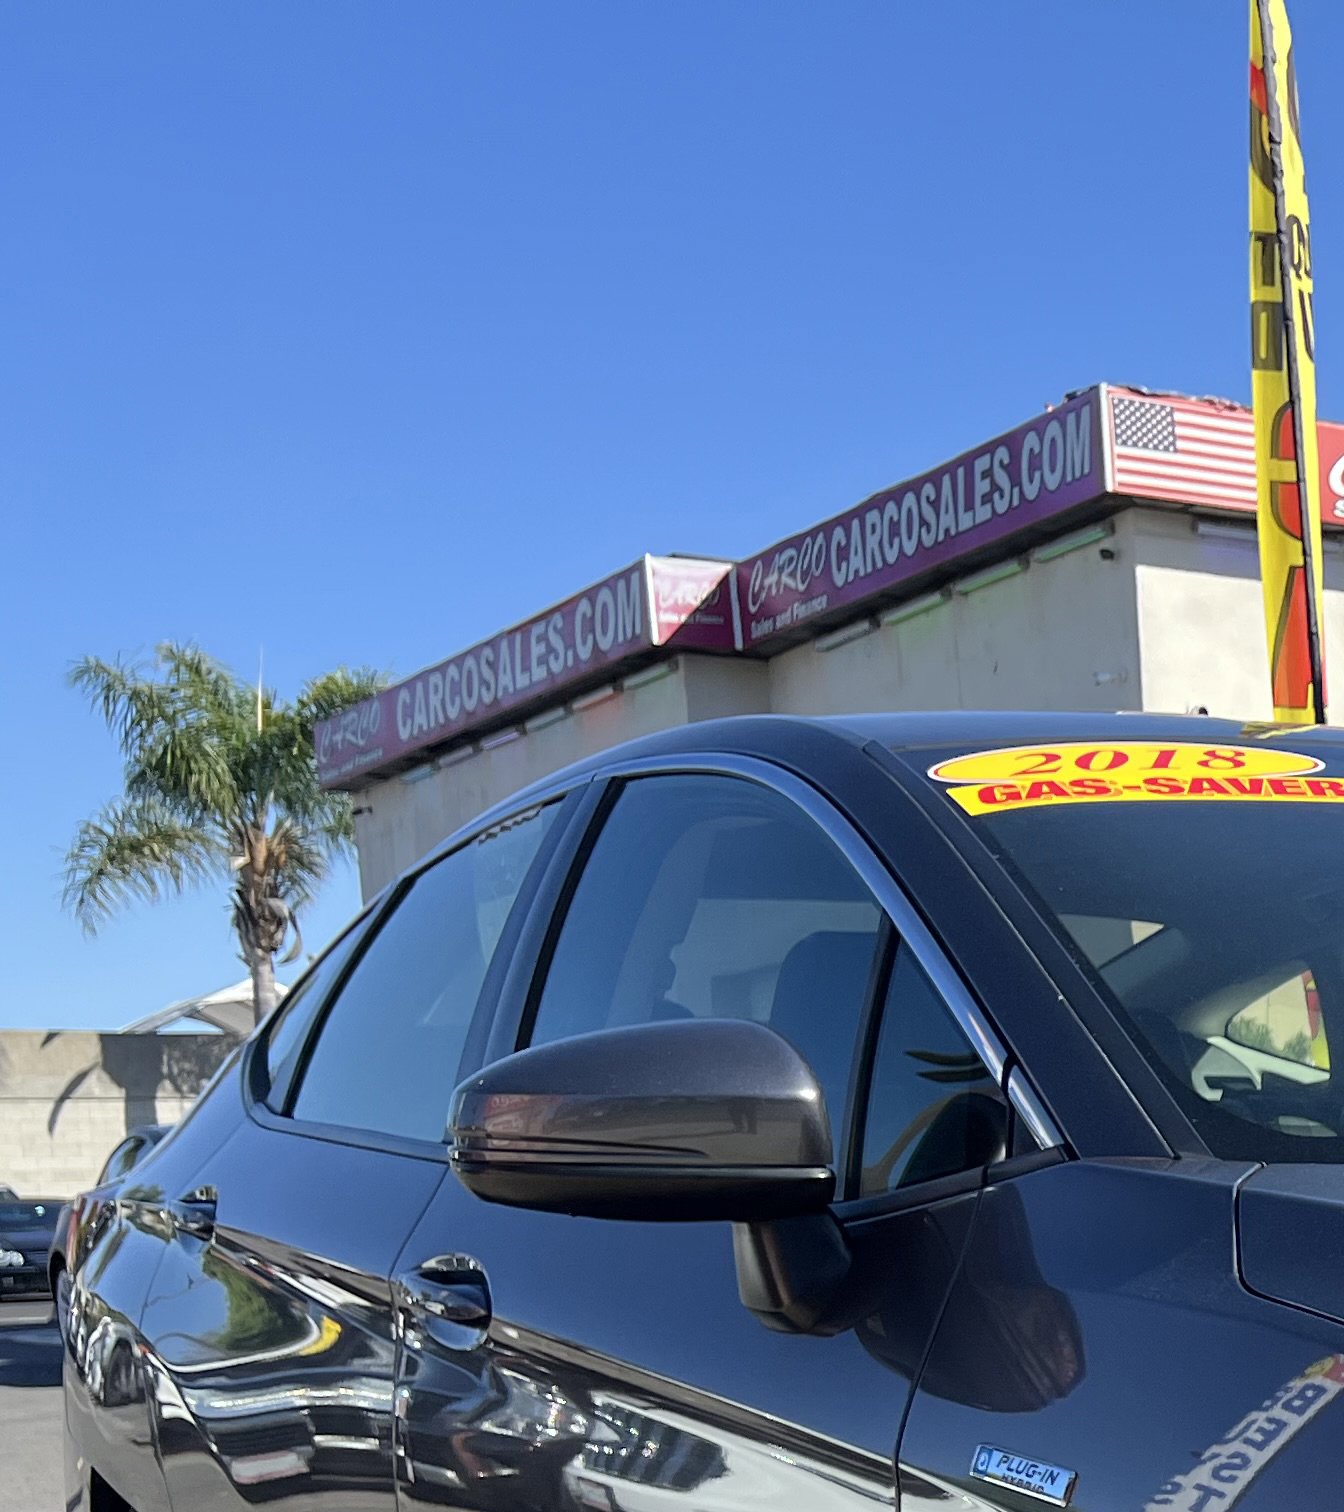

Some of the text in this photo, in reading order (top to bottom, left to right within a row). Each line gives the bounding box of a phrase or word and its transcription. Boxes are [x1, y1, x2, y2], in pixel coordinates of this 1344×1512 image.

[829, 402, 1092, 589] CARCOSALES.COM
[747, 530, 827, 615] CARCO
[396, 570, 642, 742] CARCOSALES.COM
[1009, 748, 1247, 778] 2018
[995, 1453, 1061, 1487] PLUG-IN
